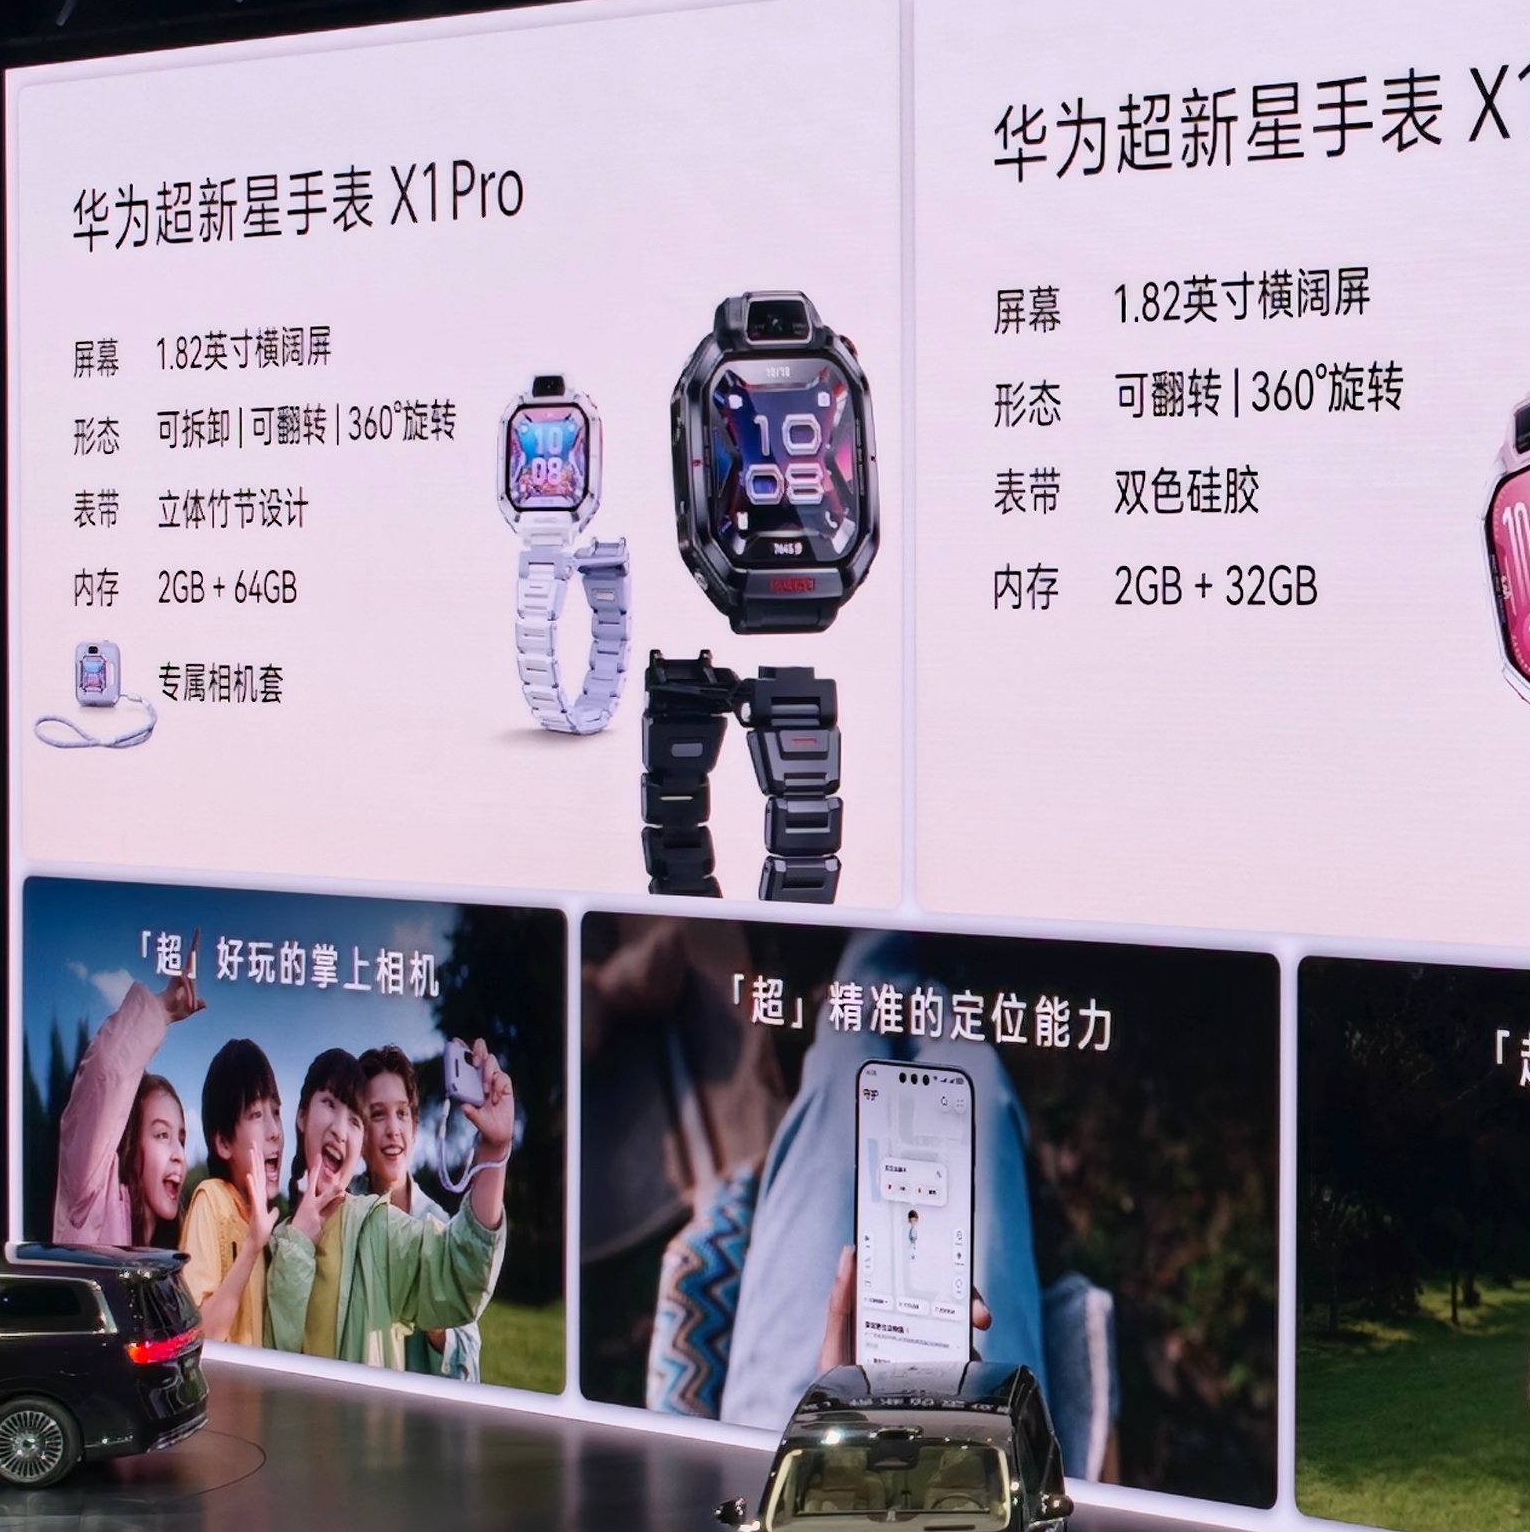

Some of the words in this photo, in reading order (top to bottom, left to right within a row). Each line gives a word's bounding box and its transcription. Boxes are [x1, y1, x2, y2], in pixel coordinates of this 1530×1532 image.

[993, 67, 1443, 183] 华为超新星手表
[72, 164, 374, 253] 华为超新星手表
[994, 284, 1061, 335] 屏幕
[1114, 266, 1371, 324] 1.82英寸横阔屏
[73, 337, 119, 379] 屏幕
[156, 325, 332, 371] 1.82英寸横阔屏
[994, 379, 1062, 428] 形态
[1114, 367, 1222, 419] 可翻转
[1251, 359, 1404, 413] 360°旋转
[73, 416, 120, 456] 形态
[535, 426, 565, 455] 10
[753, 413, 822, 456] 10
[531, 457, 564, 486] 08
[994, 466, 1061, 515] 表带
[1114, 464, 1260, 516] 双色硅胶
[73, 489, 120, 528] 表带
[158, 486, 309, 530] 立体竹节设计
[74, 567, 119, 608] 内存
[158, 569, 205, 604] 2GB
[234, 569, 297, 604] 64GB
[994, 562, 1059, 611] 内存
[1114, 565, 1183, 606] 2GB
[1226, 564, 1318, 606] 32GB
[158, 661, 284, 704] 专属相机套
